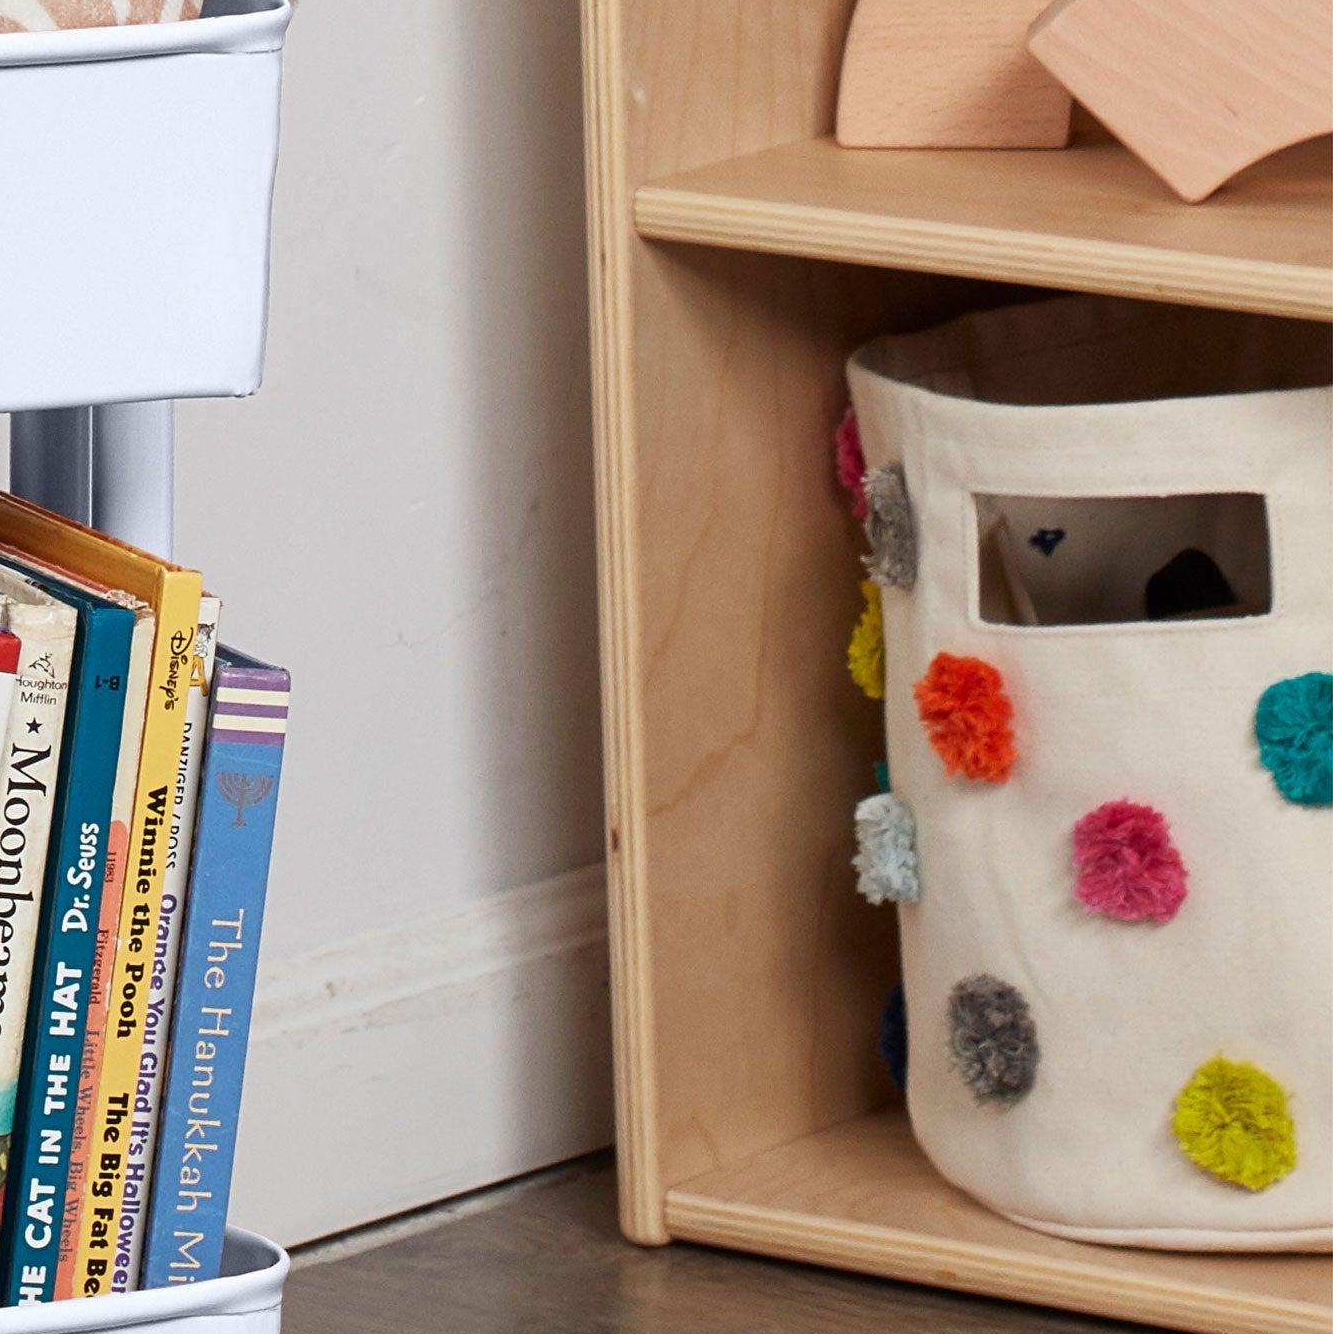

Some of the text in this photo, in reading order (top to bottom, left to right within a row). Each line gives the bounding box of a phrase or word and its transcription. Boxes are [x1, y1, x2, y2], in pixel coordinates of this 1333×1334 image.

[20, 692, 57, 705] Mifflin
[67, 822, 99, 890] Seuss
[62, 894, 90, 932] Dr.
[116, 785, 168, 1039] Winnie the Pooh
[150, 893, 177, 990] Orange
[49, 962, 82, 1036] HAT
[89, 929, 110, 1004] Fitzgerald
[142, 997, 165, 1045] You
[44, 1054, 71, 1116] THE
[80, 1029, 100, 1080] Little
[133, 1051, 158, 1116] Glad
[168, 908, 244, 1283] The Hanukkah Mi
[38, 1130, 62, 1165] IN
[128, 1120, 151, 1157] It's
[66, 1161, 83, 1192] Big
[84, 1093, 129, 1297] The Big Fat Be
[24, 1178, 56, 1249] CAT
[59, 1197, 79, 1262] Wheels
